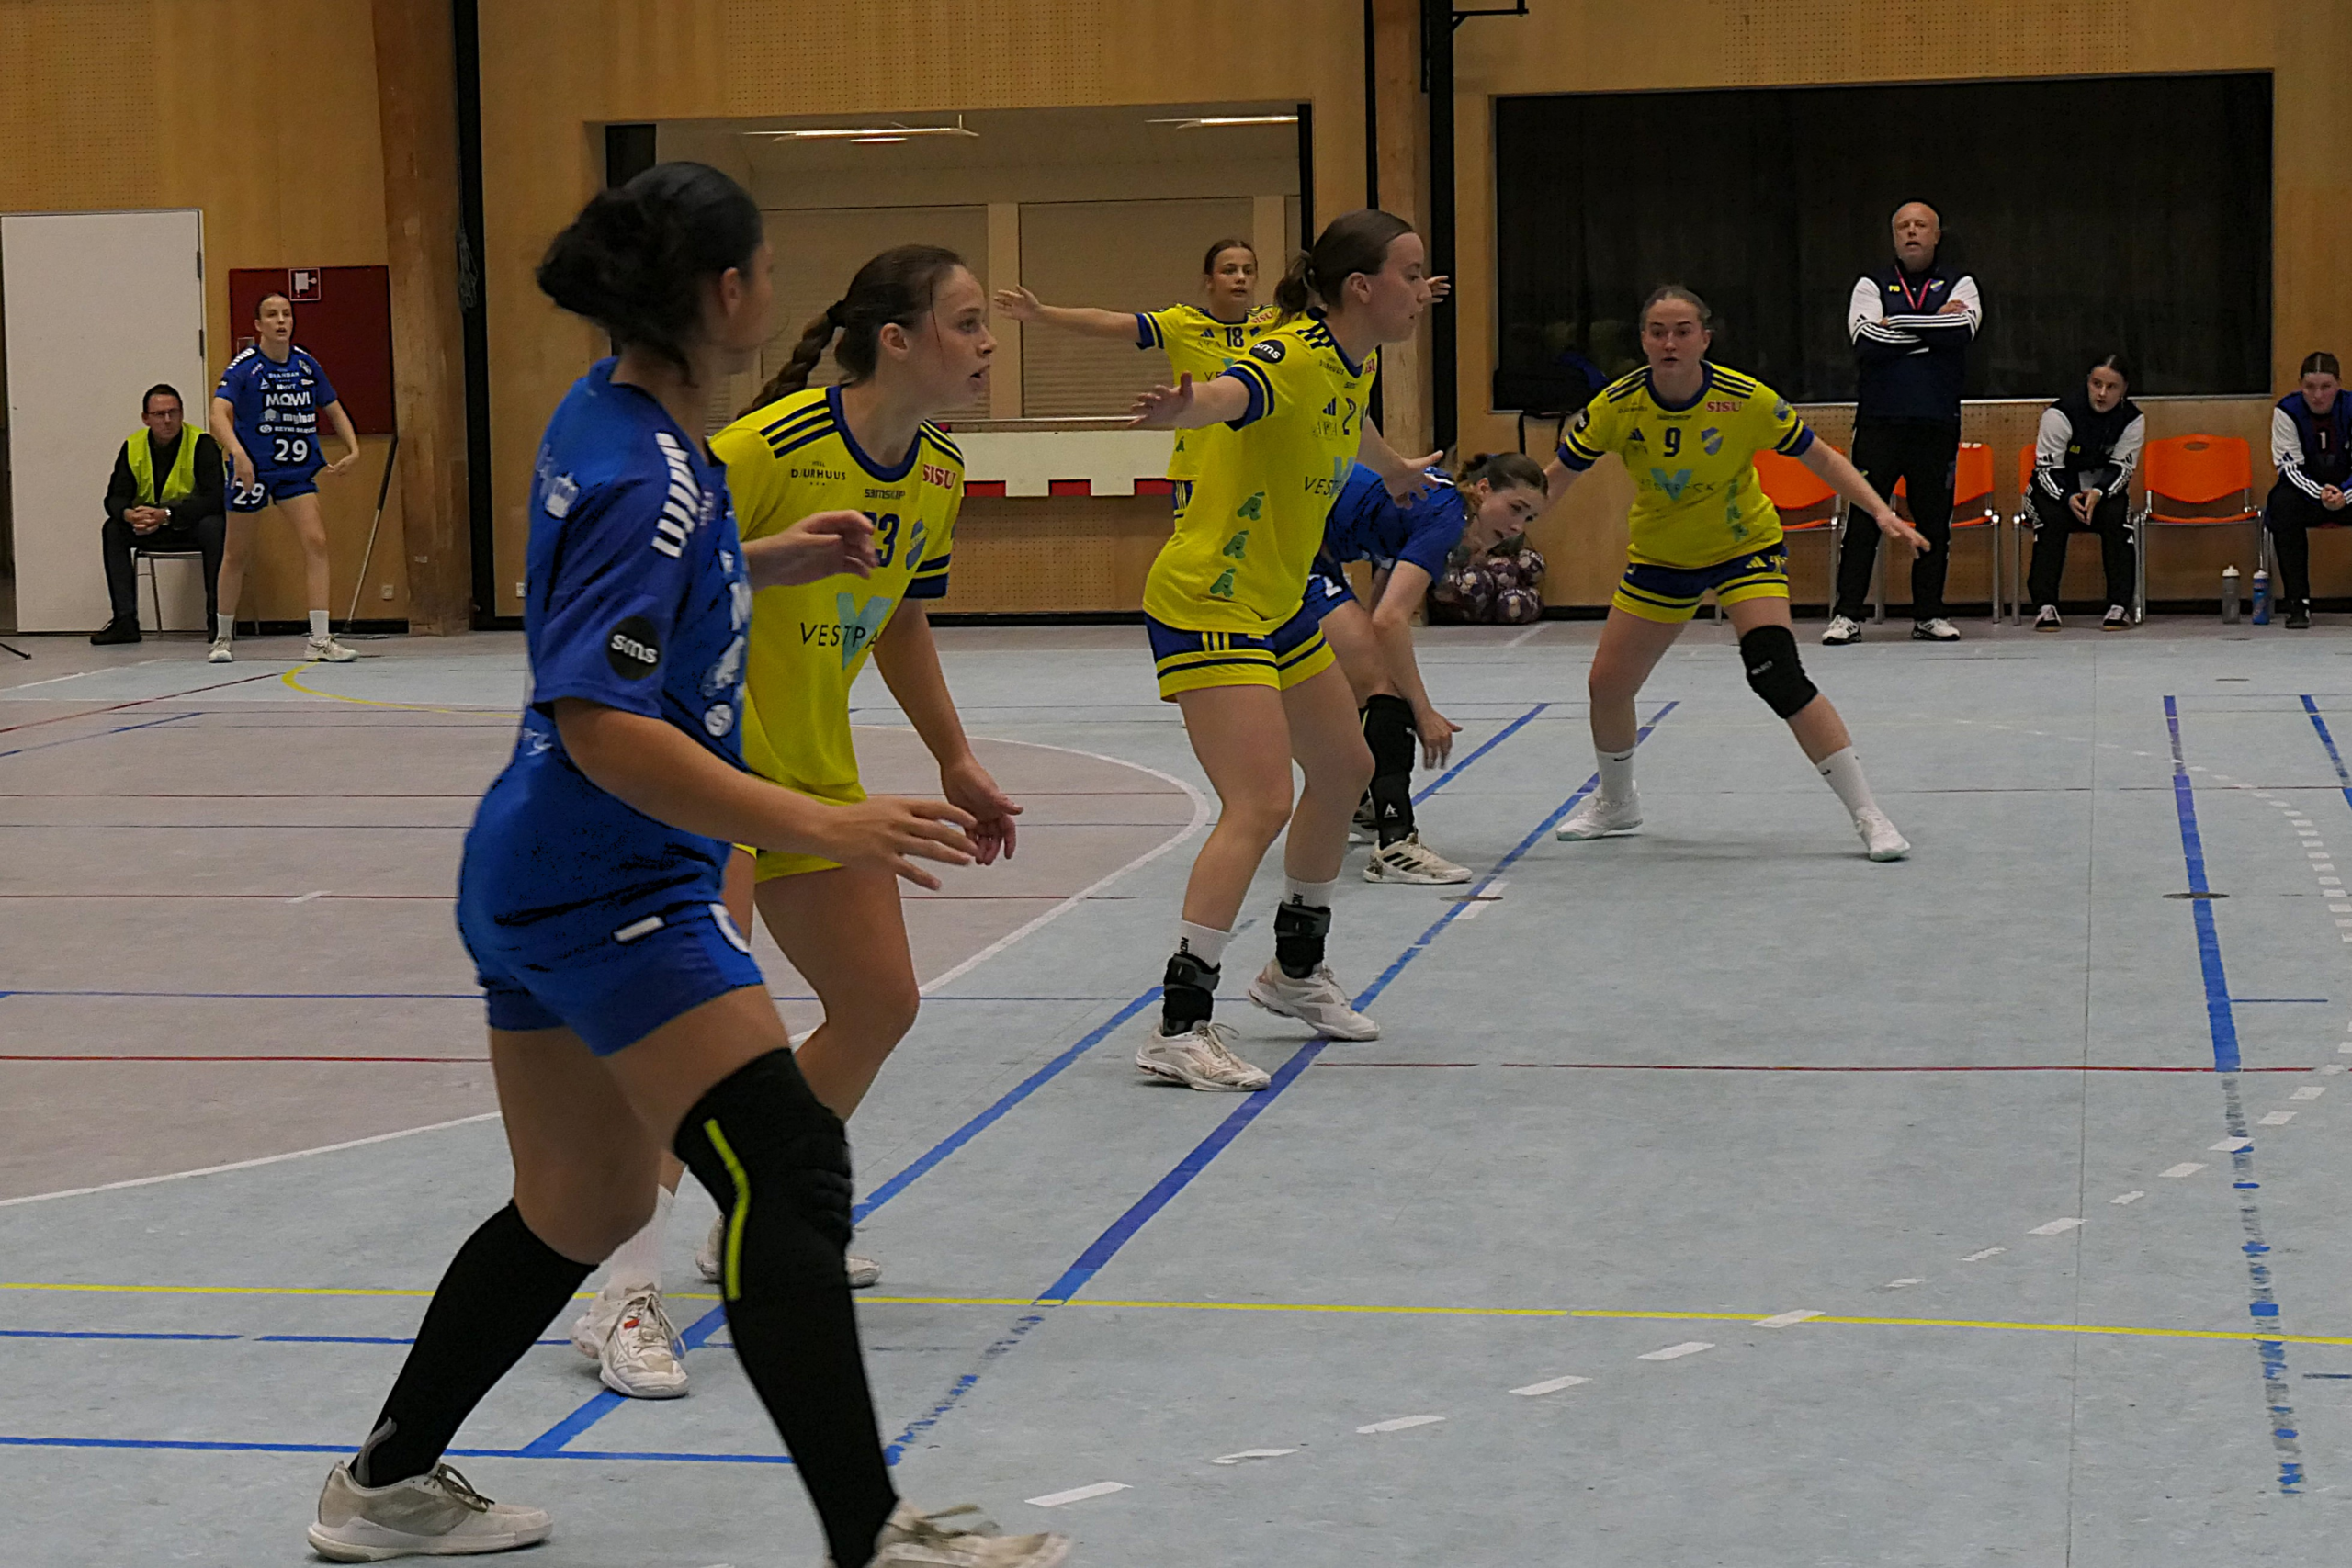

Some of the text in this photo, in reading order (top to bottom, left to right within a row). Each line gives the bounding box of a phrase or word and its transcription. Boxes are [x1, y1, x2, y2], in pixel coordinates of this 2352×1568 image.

[1250, 311, 1273, 323] SISU
[1224, 326, 1245, 347] 18
[1253, 343, 1282, 359] sms
[1342, 397, 1357, 435] 2
[1706, 401, 1743, 412] SISU
[274, 438, 308, 462] 29
[1663, 427, 1681, 457] 9
[2319, 431, 2327, 450] 1
[922, 464, 956, 490] SISU
[232, 481, 266, 504] 29
[611, 634, 659, 663] sms
